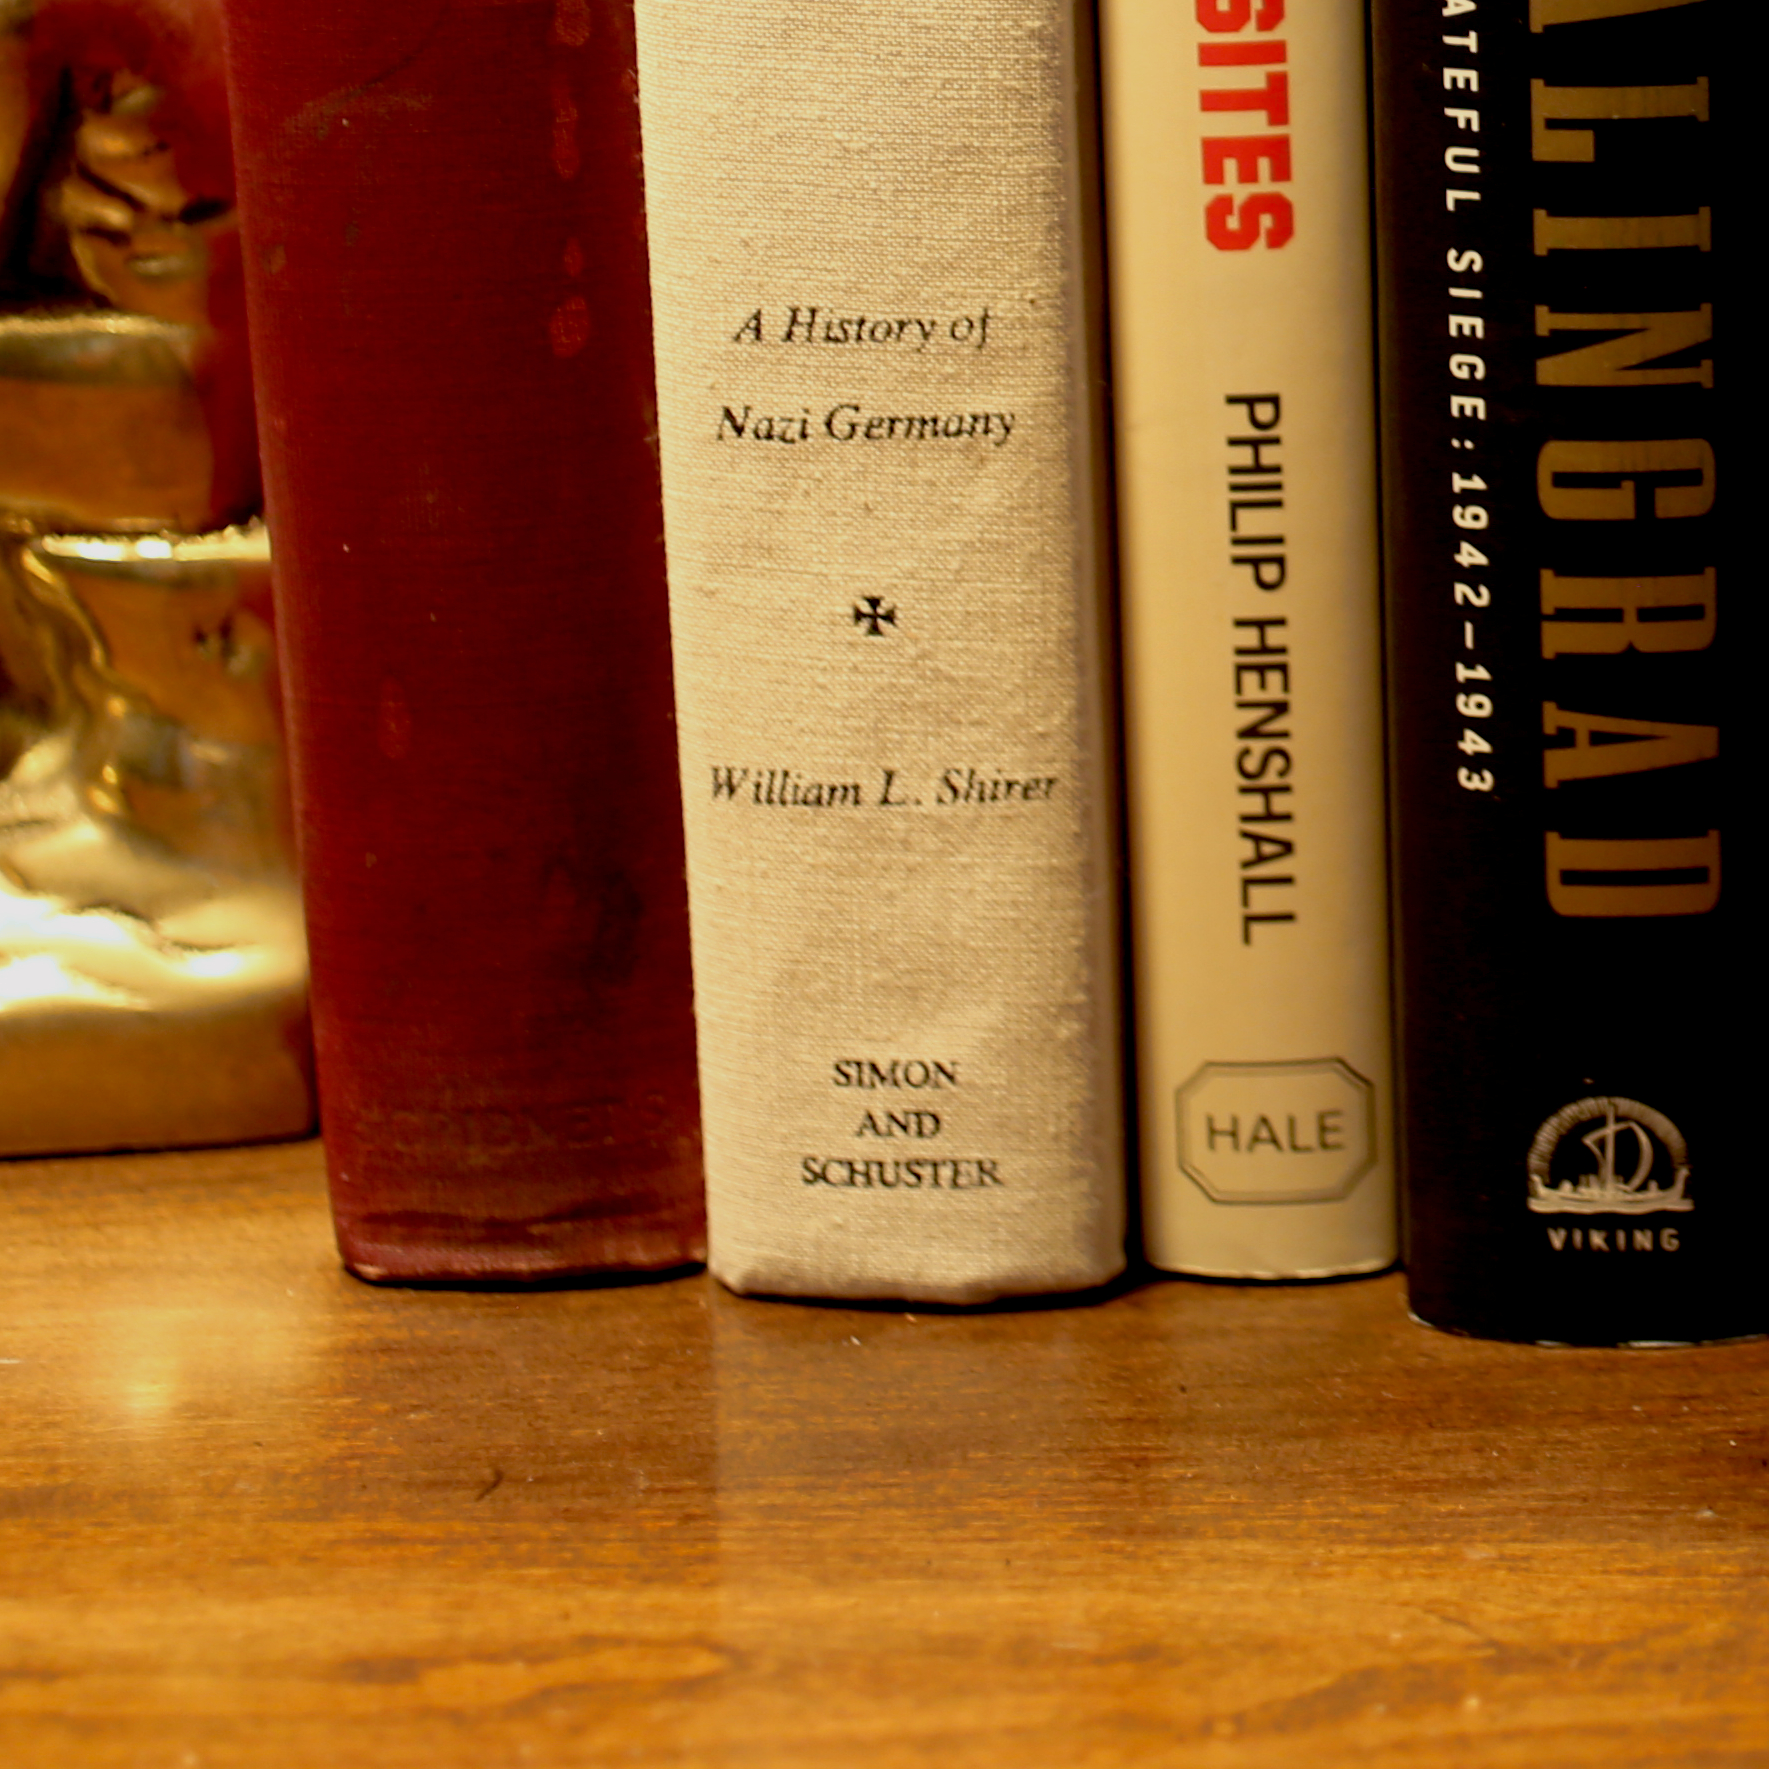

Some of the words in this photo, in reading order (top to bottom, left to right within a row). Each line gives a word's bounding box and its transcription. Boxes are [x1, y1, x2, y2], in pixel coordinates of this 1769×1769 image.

[733, 307, 764, 343] A
[781, 305, 936, 353] History
[951, 305, 991, 350] of
[716, 403, 810, 445] Nazi
[824, 402, 1016, 449] Germany
[1224, 392, 1288, 593] PHILIP
[709, 764, 862, 808] William
[877, 769, 923, 808] L.
[935, 767, 1060, 806] Shirer
[1232, 616, 1298, 945] HENSHALL
[832, 1060, 960, 1089] SIMON
[856, 1109, 941, 1139] AND
[1206, 1108, 1346, 1153] HALE
[802, 1156, 1005, 1190] SCHUSTER
[1547, 1228, 1681, 1252] VIKING
